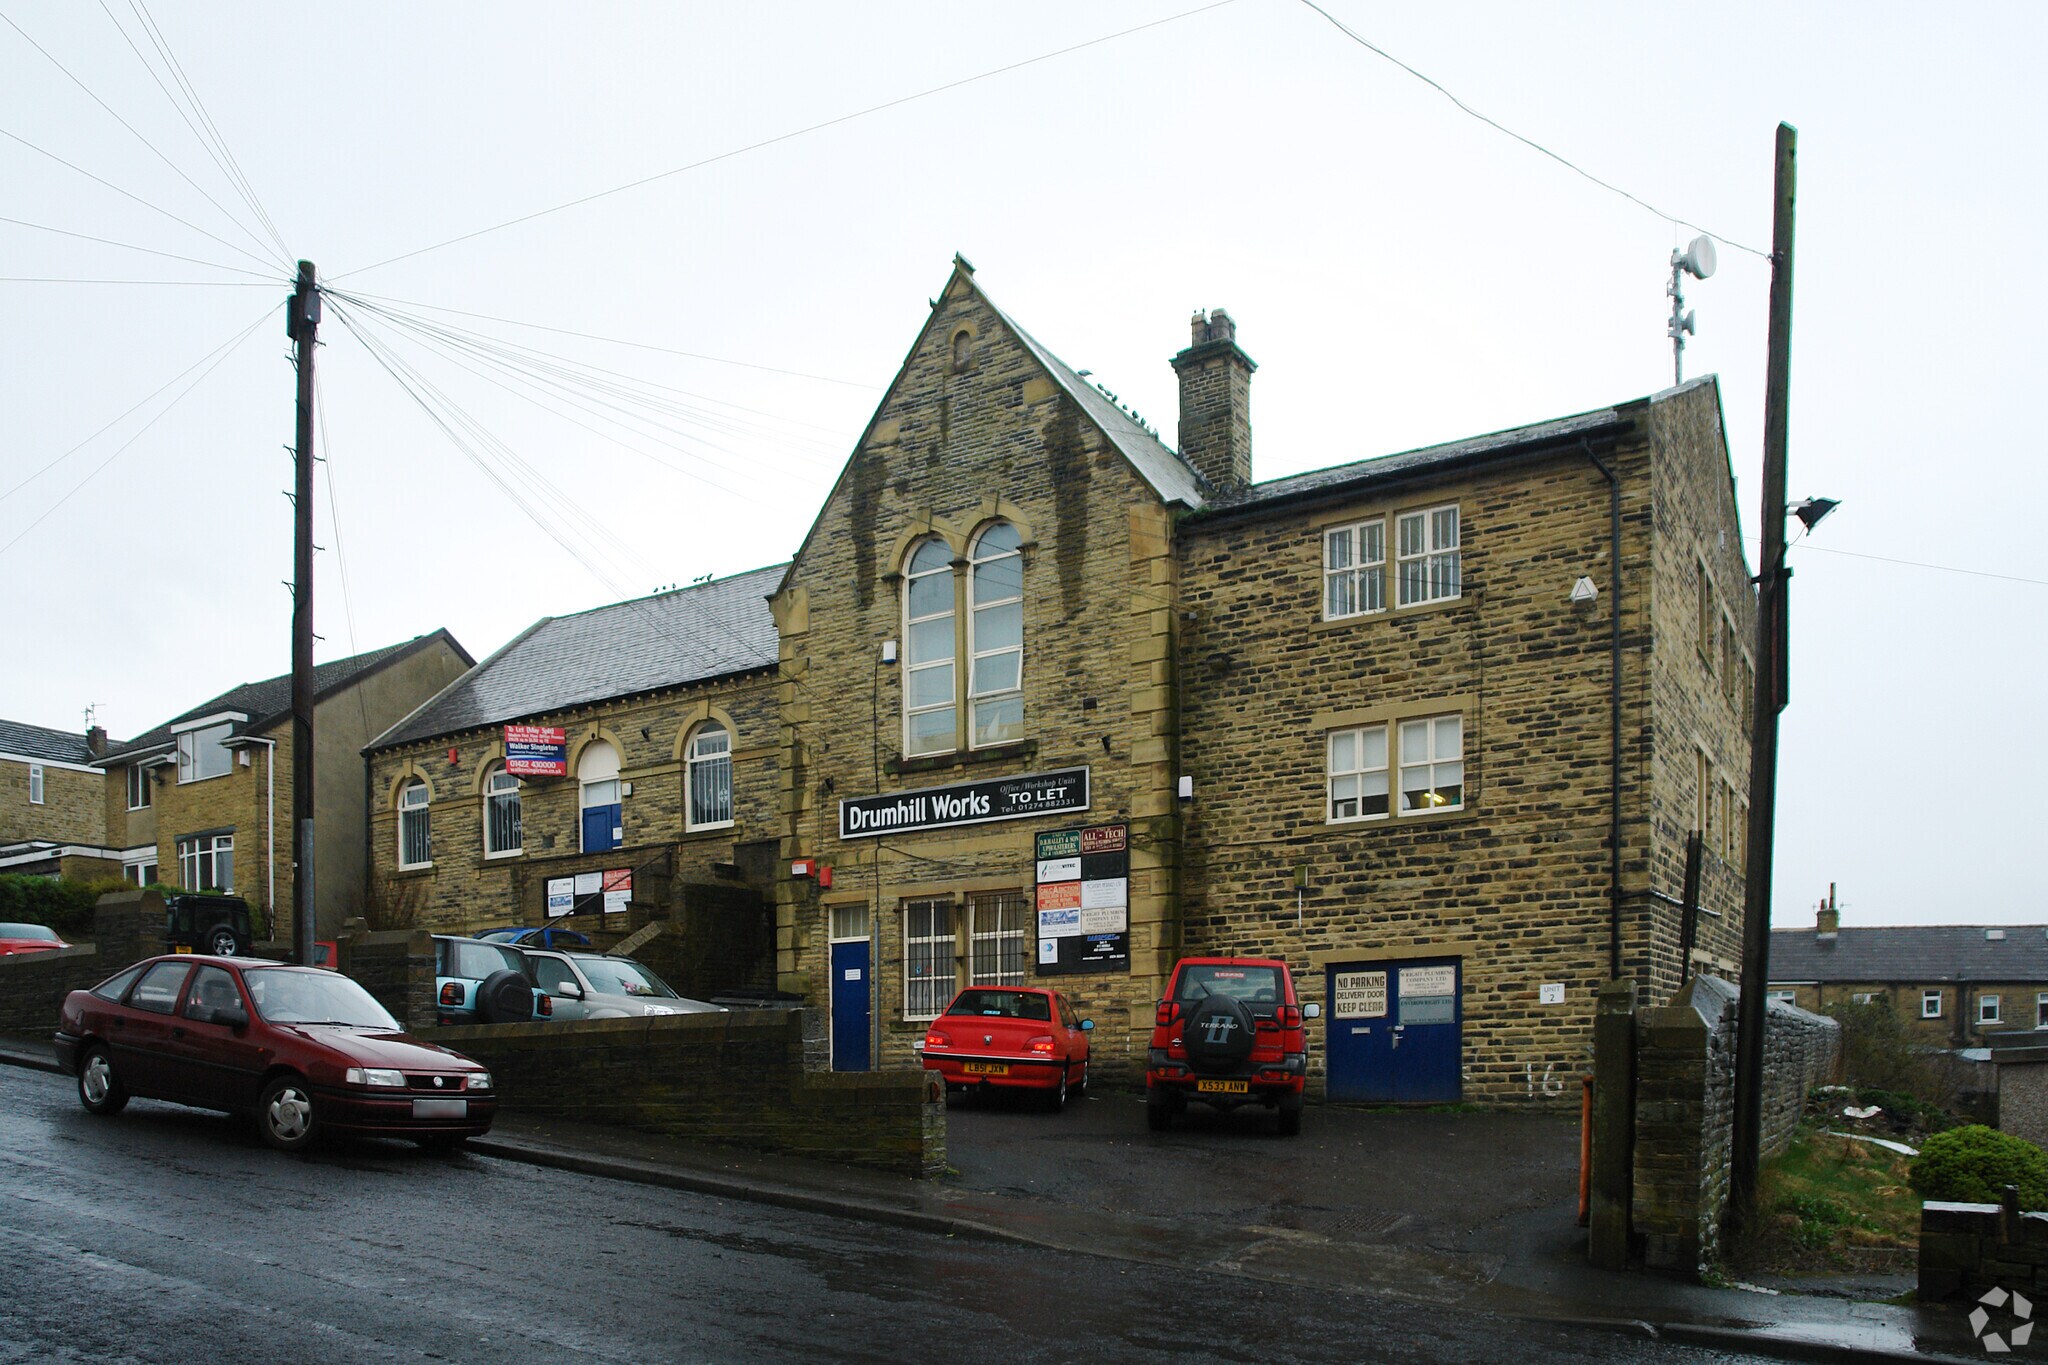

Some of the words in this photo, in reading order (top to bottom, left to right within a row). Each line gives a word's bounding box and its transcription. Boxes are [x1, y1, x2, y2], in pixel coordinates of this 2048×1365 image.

[530, 744, 559, 752] Singleton
[1000, 779, 1056, 795] Office/Workshop
[1058, 777, 1076, 786] Units
[1009, 791, 1032, 804] TO
[1037, 787, 1067, 801] LET
[850, 796, 926, 830] Drumhill
[931, 790, 990, 819] Works
[1018, 802, 1043, 811] 01274
[1045, 798, 1075, 808] 882331
[1084, 832, 1097, 841] ALL
[1105, 828, 1124, 839] TECH
[1337, 978, 1348, 988] NO
[1350, 975, 1385, 988] PARKING
[1337, 991, 1366, 1000] DELIVERY
[1367, 990, 1385, 999] DOOR
[1543, 985, 1561, 993] UNIT
[1549, 993, 1555, 1002] 2
[1337, 1002, 1357, 1013] KEEP
[1358, 1001, 1384, 1013] CLEAR
[1200, 1022, 1239, 1030] TERRANO
[968, 1063, 987, 1073] LB51
[988, 1064, 1005, 1074] JXN
[1527, 1062, 1563, 1097] 16
[1201, 1081, 1226, 1091] X533
[1228, 1081, 1246, 1091] ANW
